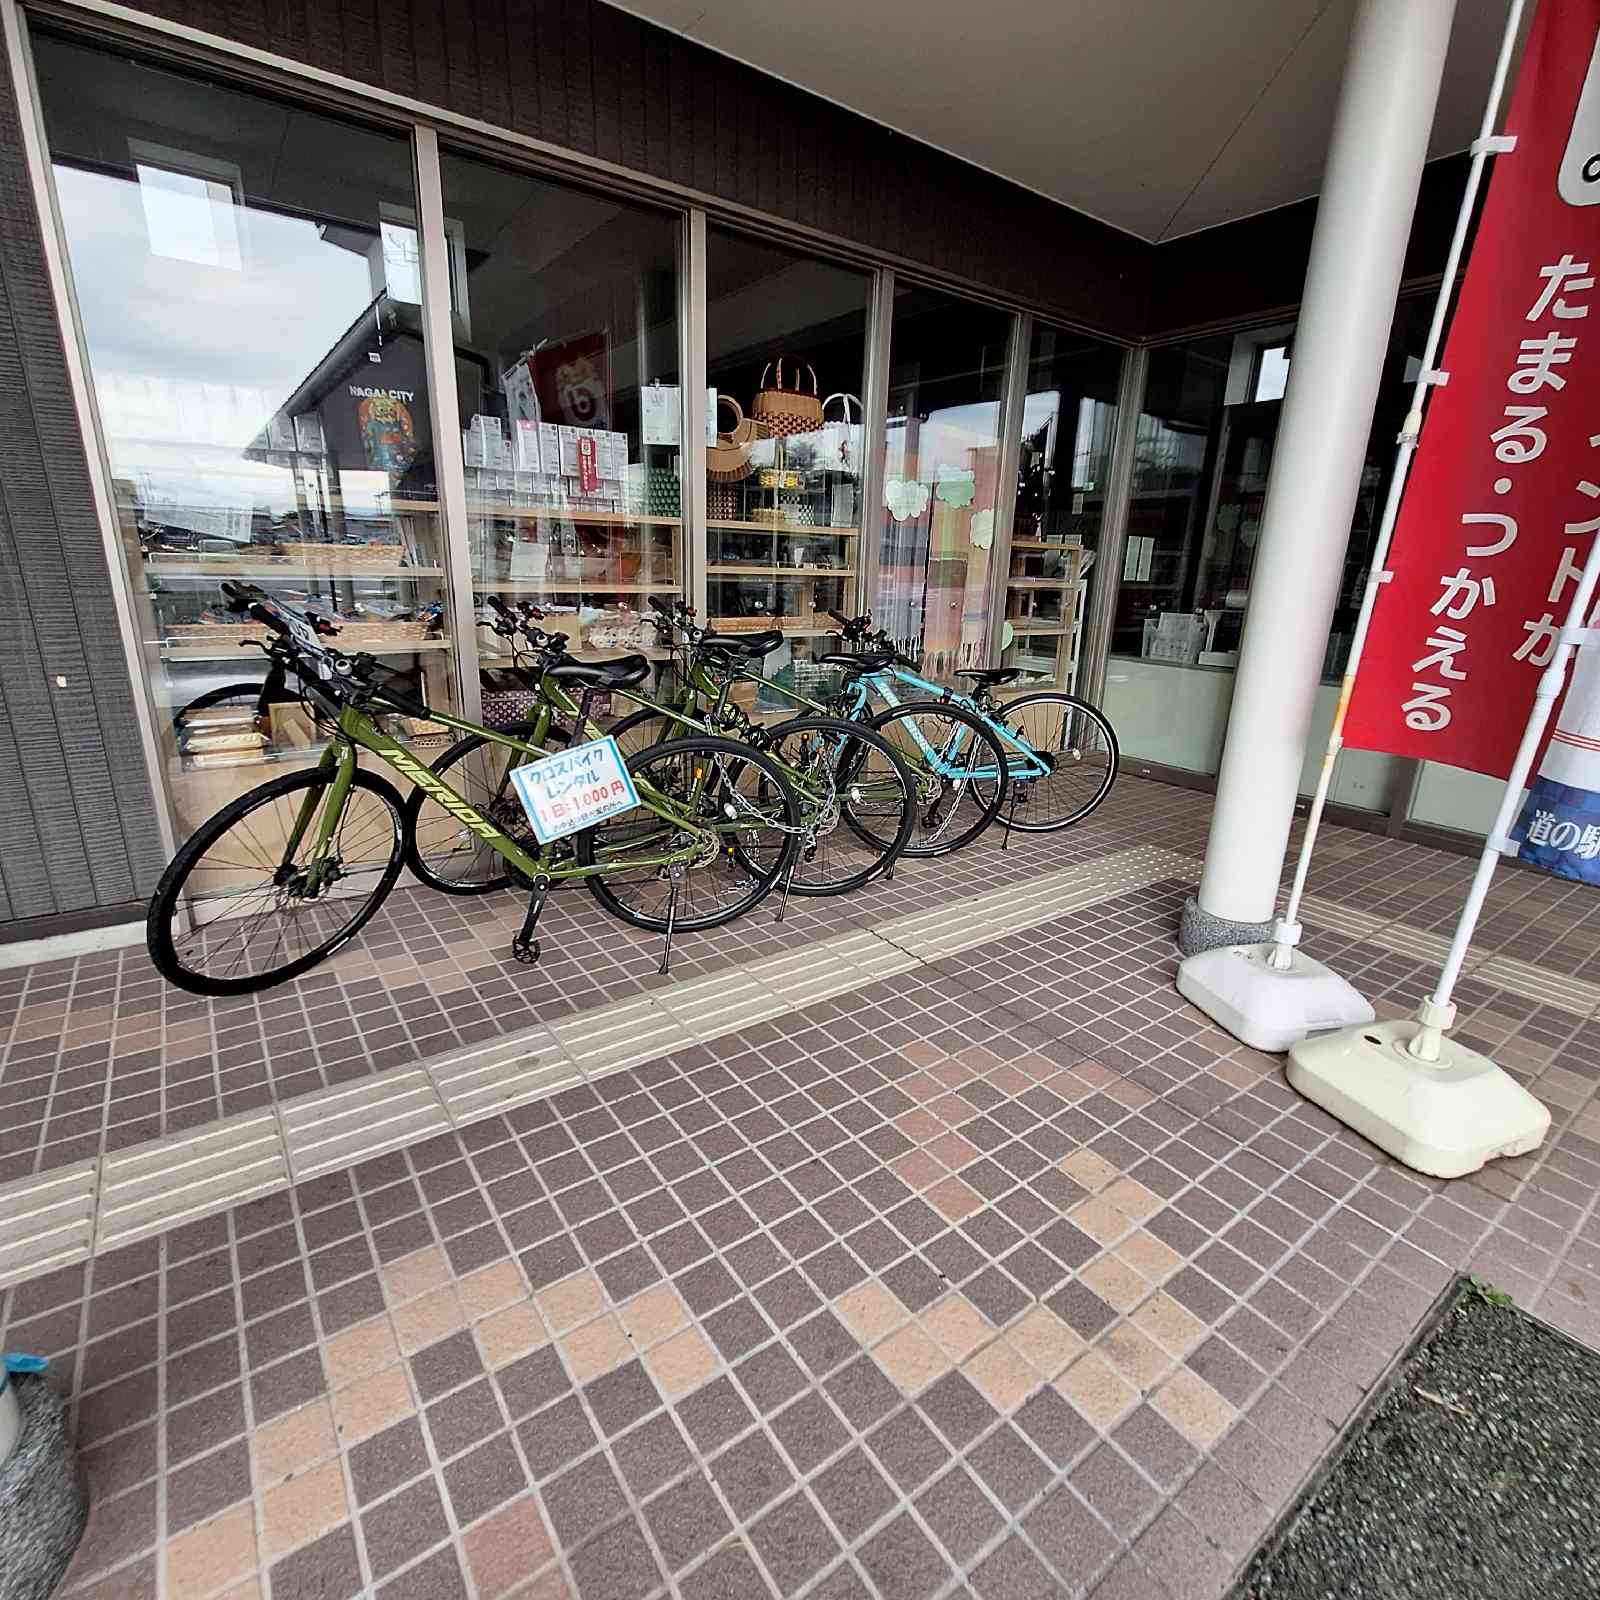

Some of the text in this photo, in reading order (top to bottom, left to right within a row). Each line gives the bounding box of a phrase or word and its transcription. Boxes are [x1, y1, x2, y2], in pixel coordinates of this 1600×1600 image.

[388, 389, 414, 402] CITY
[1401, 254, 1595, 731] たまる・つかえる
[530, 749, 603, 784] クロスバイク
[546, 769, 600, 799] レンタル
[377, 749, 502, 838] MERIDA
